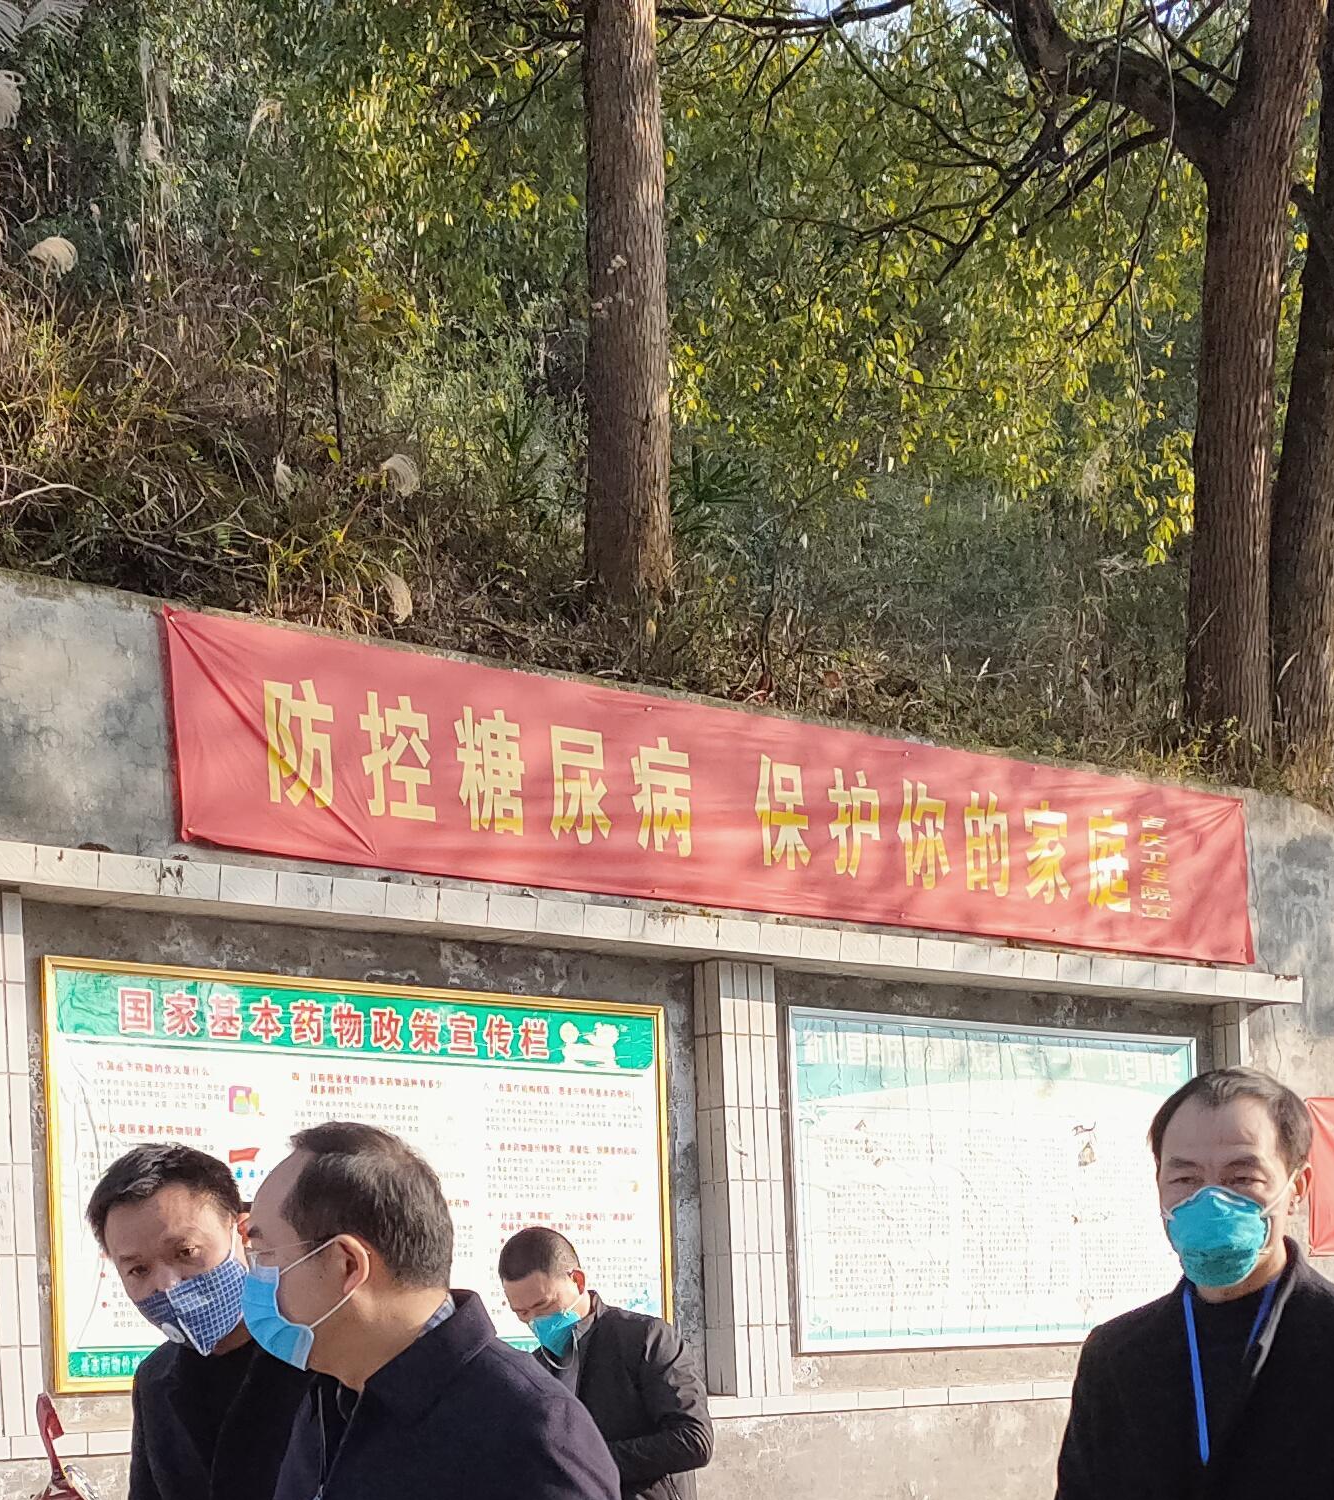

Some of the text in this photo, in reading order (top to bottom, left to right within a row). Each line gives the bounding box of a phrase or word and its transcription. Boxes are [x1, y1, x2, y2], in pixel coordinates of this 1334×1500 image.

[263, 678, 1132, 914] 防控糖尿病 保护你的家庭
[119, 988, 549, 1058] 国家基本药物政策宣传栏
